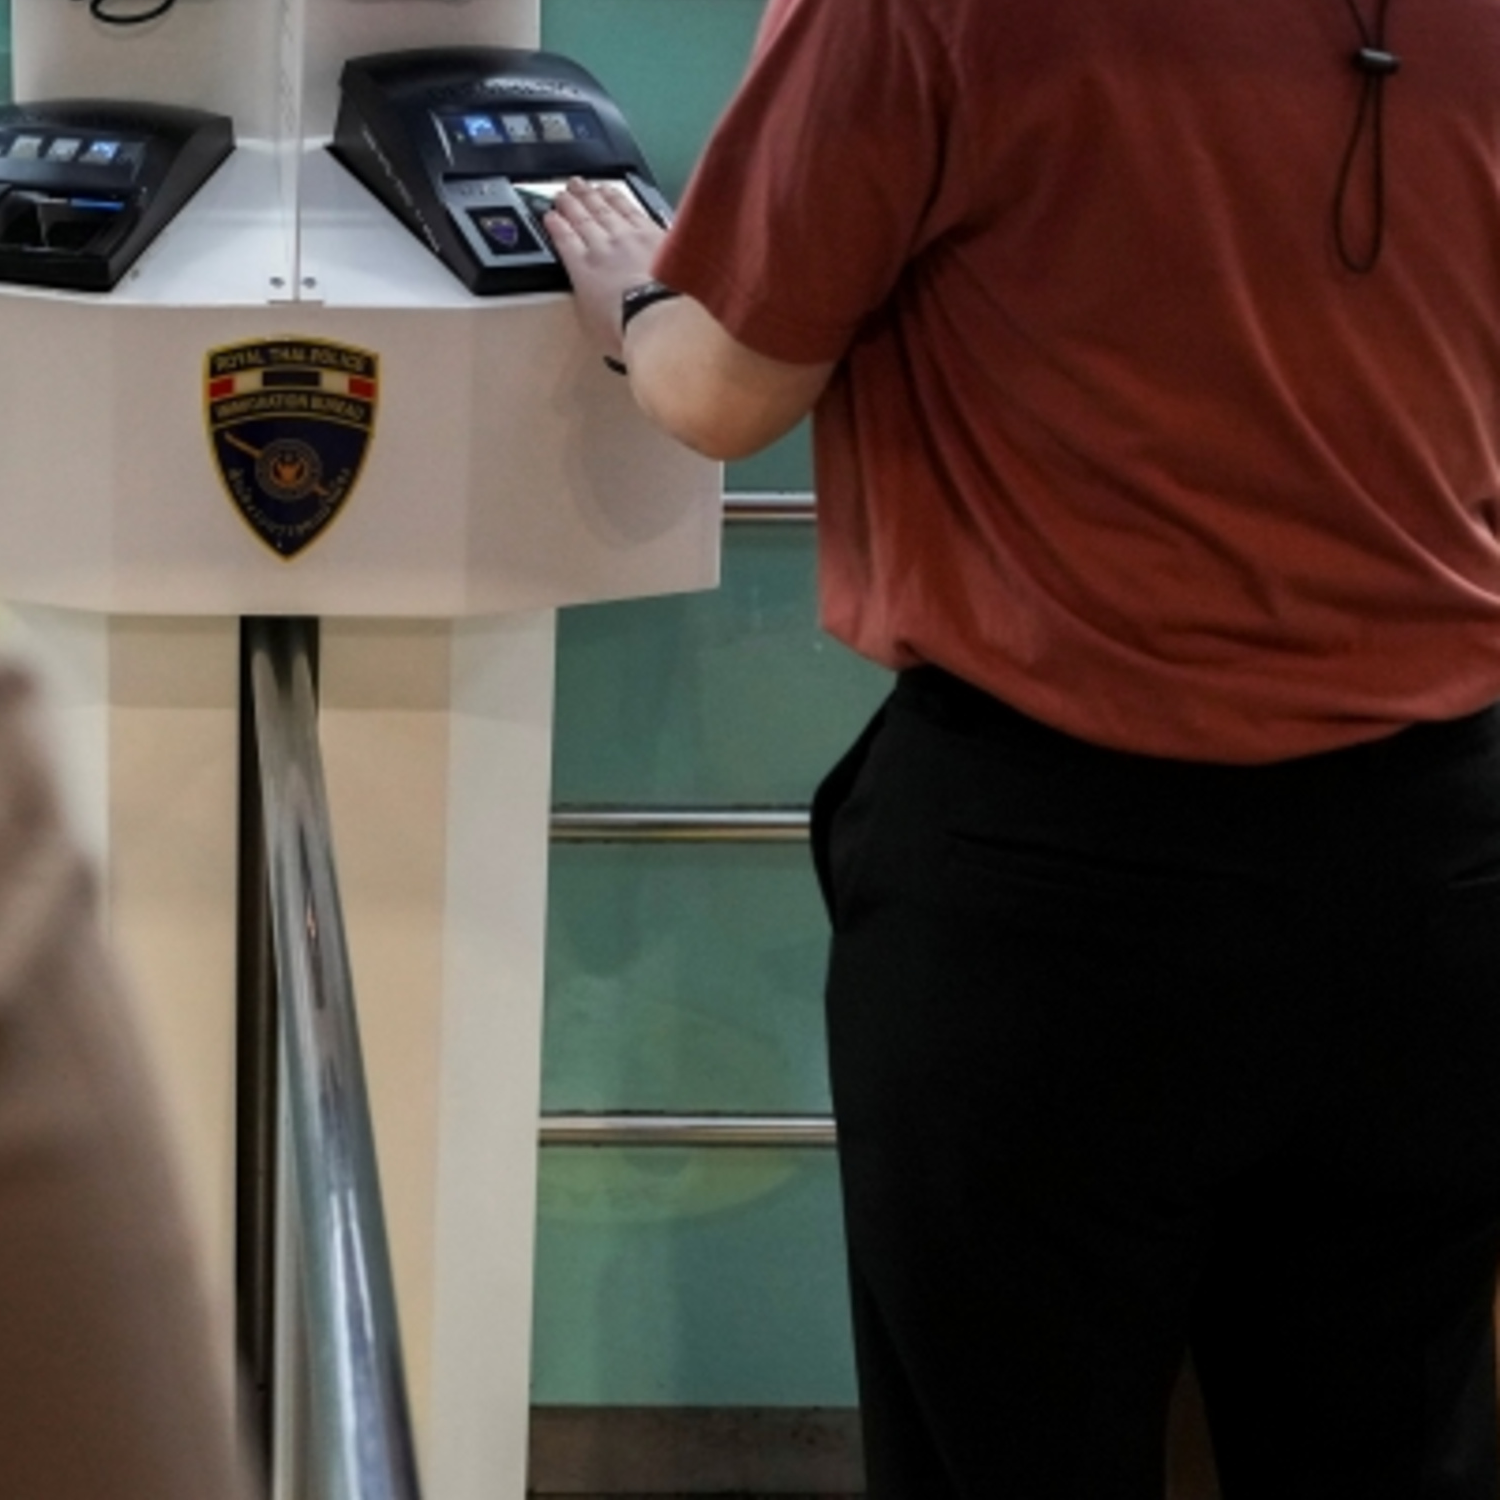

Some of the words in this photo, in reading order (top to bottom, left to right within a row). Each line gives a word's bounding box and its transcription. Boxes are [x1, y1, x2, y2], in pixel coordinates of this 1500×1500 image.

[216, 348, 265, 371] ROYAL
[268, 346, 305, 361] THAI
[310, 346, 367, 371] POLICE
[215, 391, 308, 419] IMMIGRATION
[311, 393, 367, 422] BUREAU
